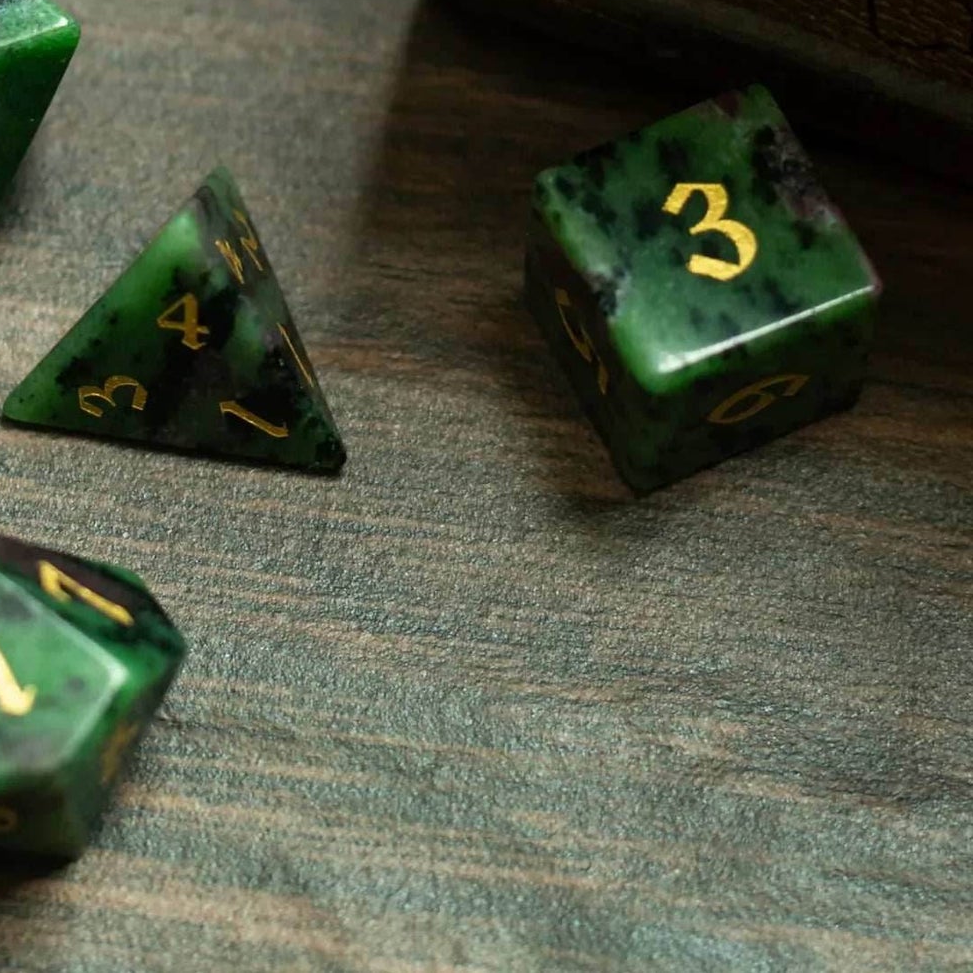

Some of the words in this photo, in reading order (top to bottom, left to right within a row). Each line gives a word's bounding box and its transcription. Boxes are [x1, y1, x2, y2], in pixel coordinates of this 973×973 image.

[660, 182, 758, 282] 3
[157, 293, 210, 350] 4
[78, 376, 148, 418] 3
[219, 400, 289, 438] 1
[707, 373, 811, 424] 6
